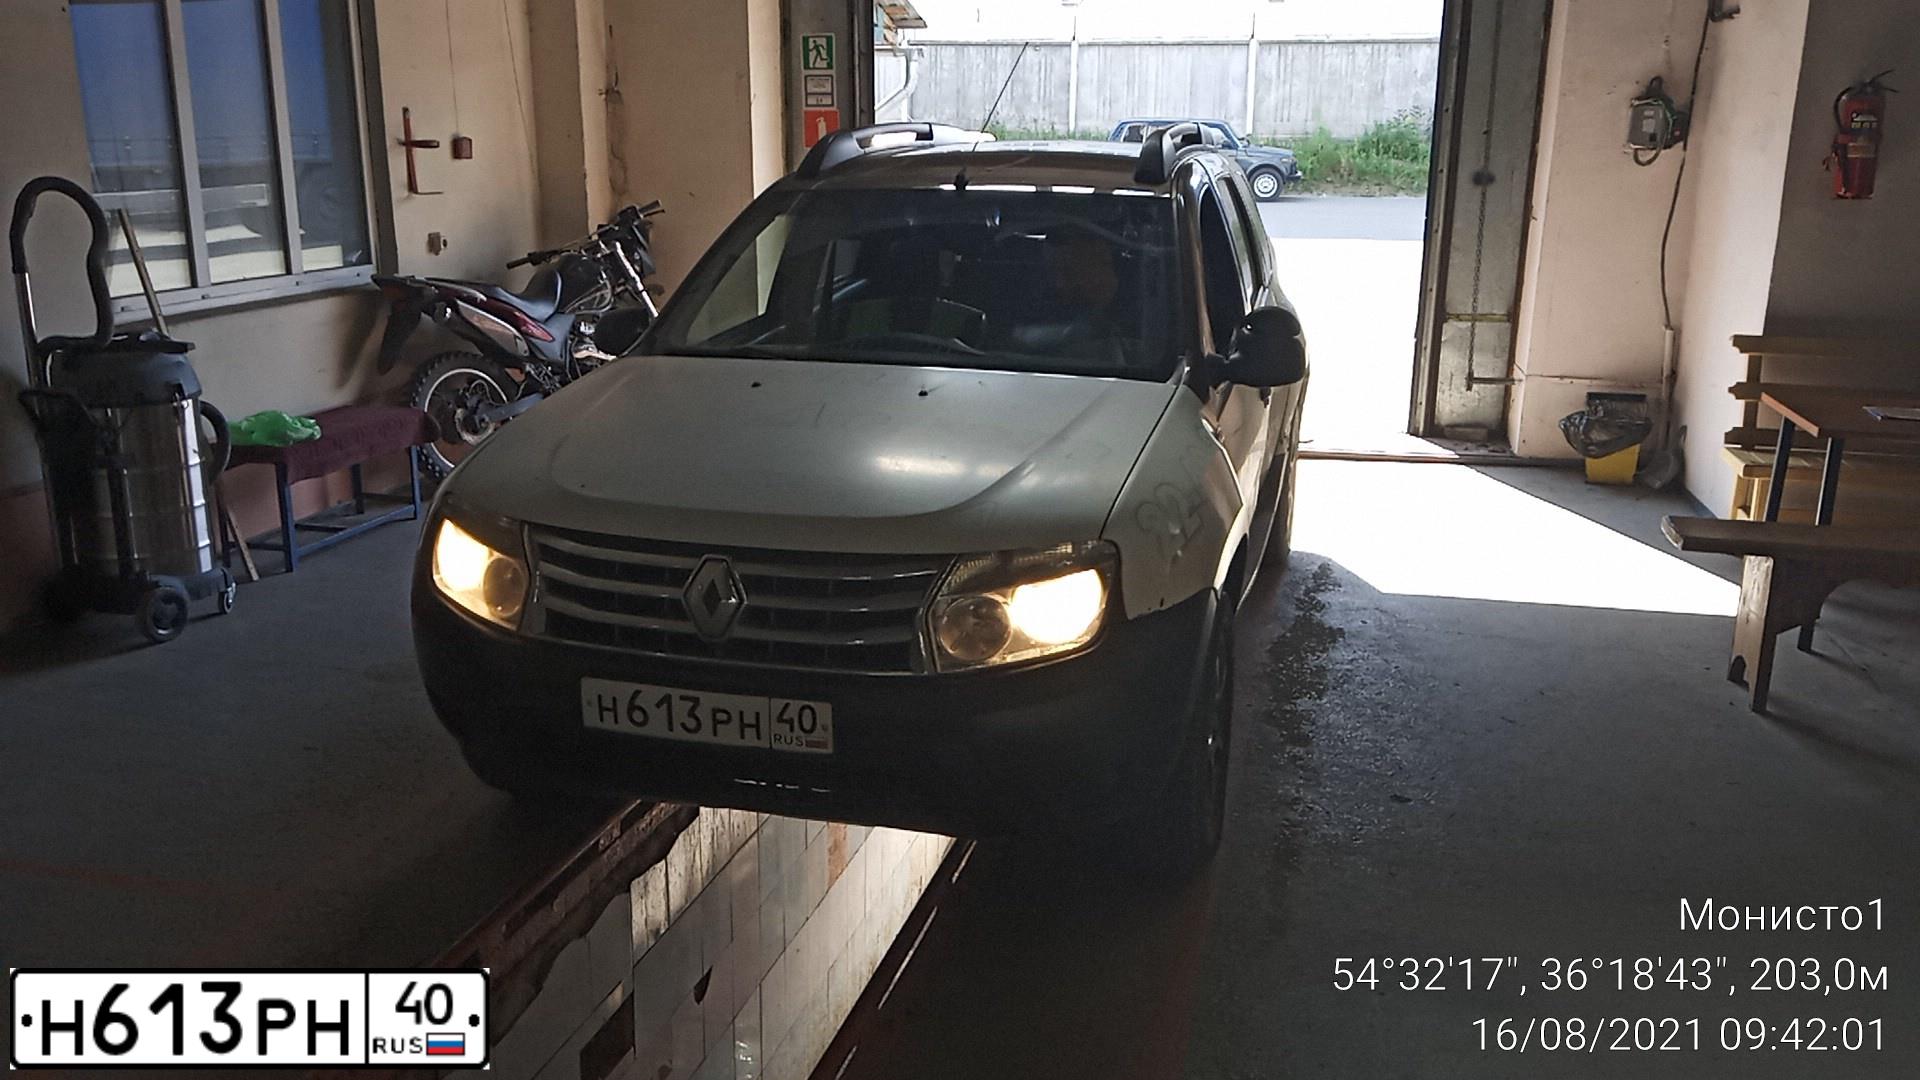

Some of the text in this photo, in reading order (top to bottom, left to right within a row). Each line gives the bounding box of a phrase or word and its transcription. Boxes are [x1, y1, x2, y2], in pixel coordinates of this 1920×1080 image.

[597, 689, 818, 741] Н613РН 40
[773, 733, 804, 747] RUS
